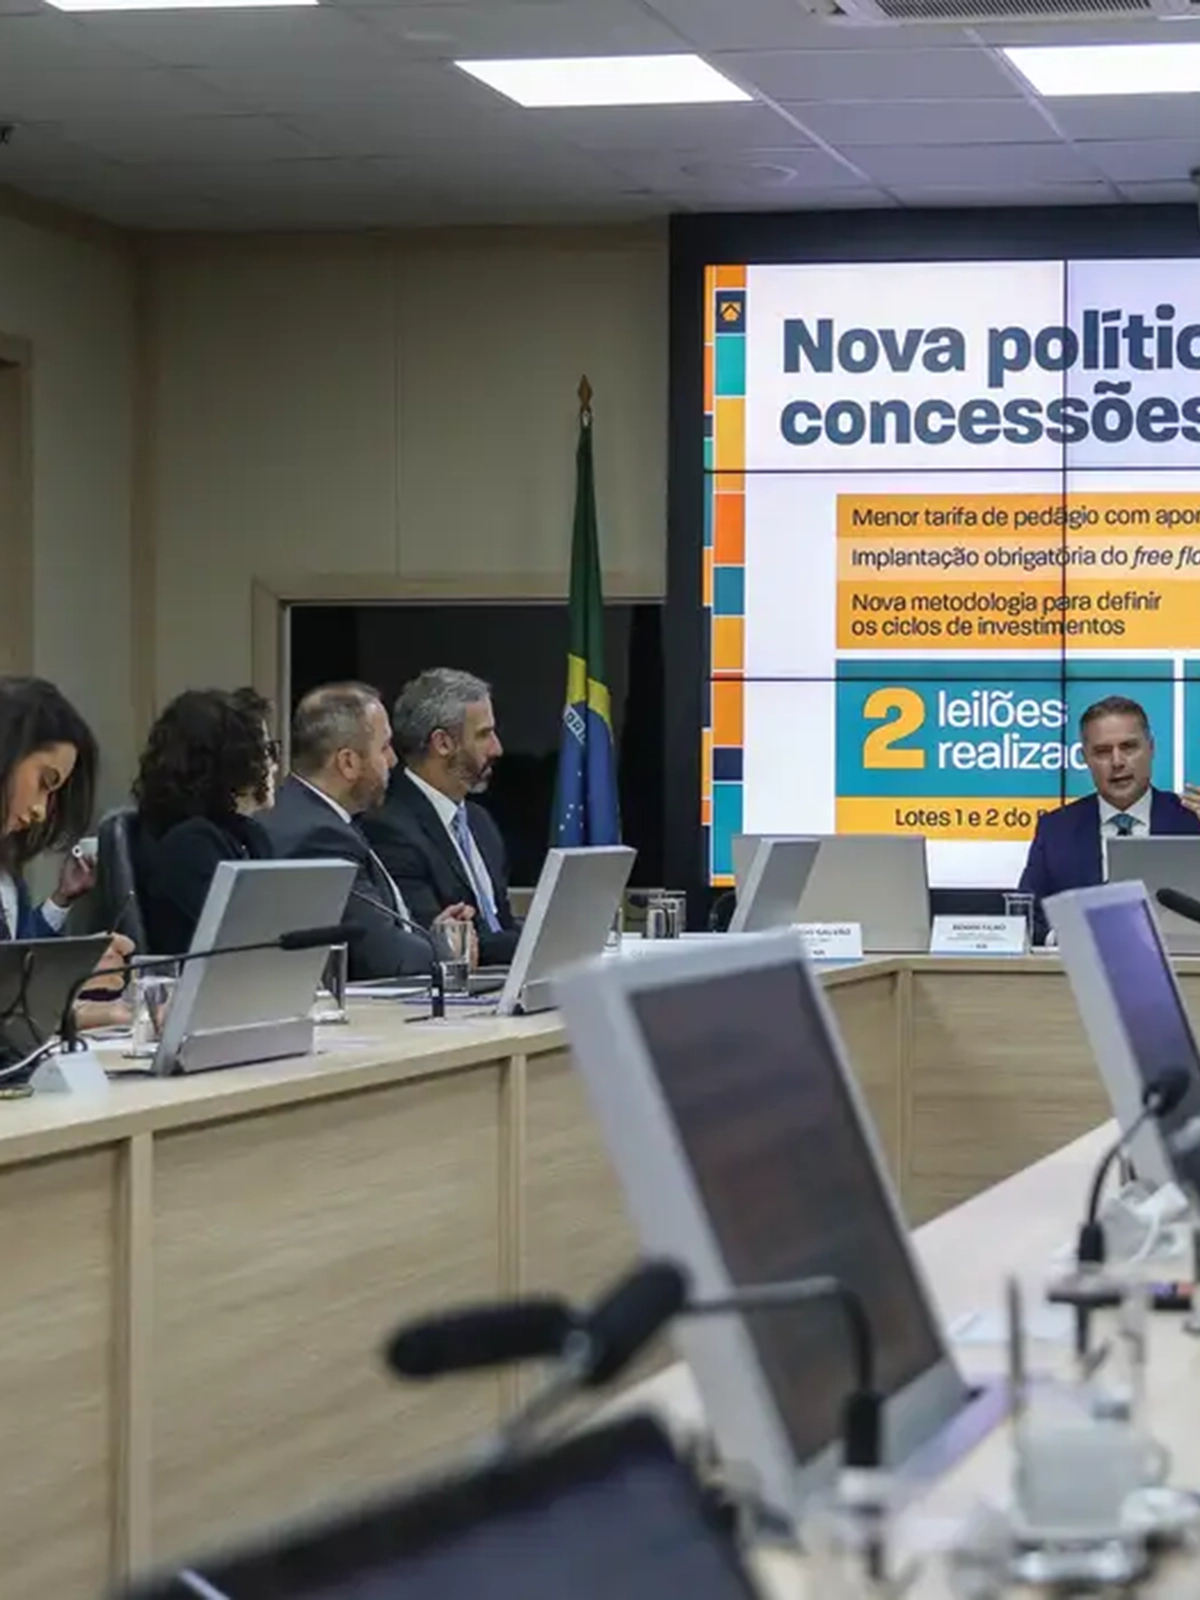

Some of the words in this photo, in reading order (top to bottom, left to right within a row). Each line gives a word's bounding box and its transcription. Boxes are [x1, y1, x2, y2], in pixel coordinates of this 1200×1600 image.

[782, 318, 966, 374] Nova
[851, 508, 919, 527] Menor
[924, 506, 978, 527] tarifa
[982, 506, 1009, 527] de
[1013, 505, 1099, 530] pedágio
[1104, 508, 1150, 525] com
[851, 546, 979, 571] Implantação
[984, 545, 1096, 571] obrigatória
[1100, 545, 1129, 566] do
[1130, 545, 1174, 570] free
[851, 593, 907, 612] Nova
[910, 592, 1038, 617] metodologia
[1042, 594, 1092, 616] para
[1096, 591, 1162, 611] definir
[851, 619, 878, 636] os
[881, 616, 942, 636] ciclos
[946, 616, 973, 636] de
[977, 616, 1126, 636] investimentos
[938, 689, 1069, 728] leilões
[863, 686, 926, 770] 2
[895, 808, 952, 827] Lotes
[955, 808, 963, 826] 1
[968, 811, 982, 827] e
[985, 808, 1000, 826] 2
[1003, 807, 1032, 828] do
